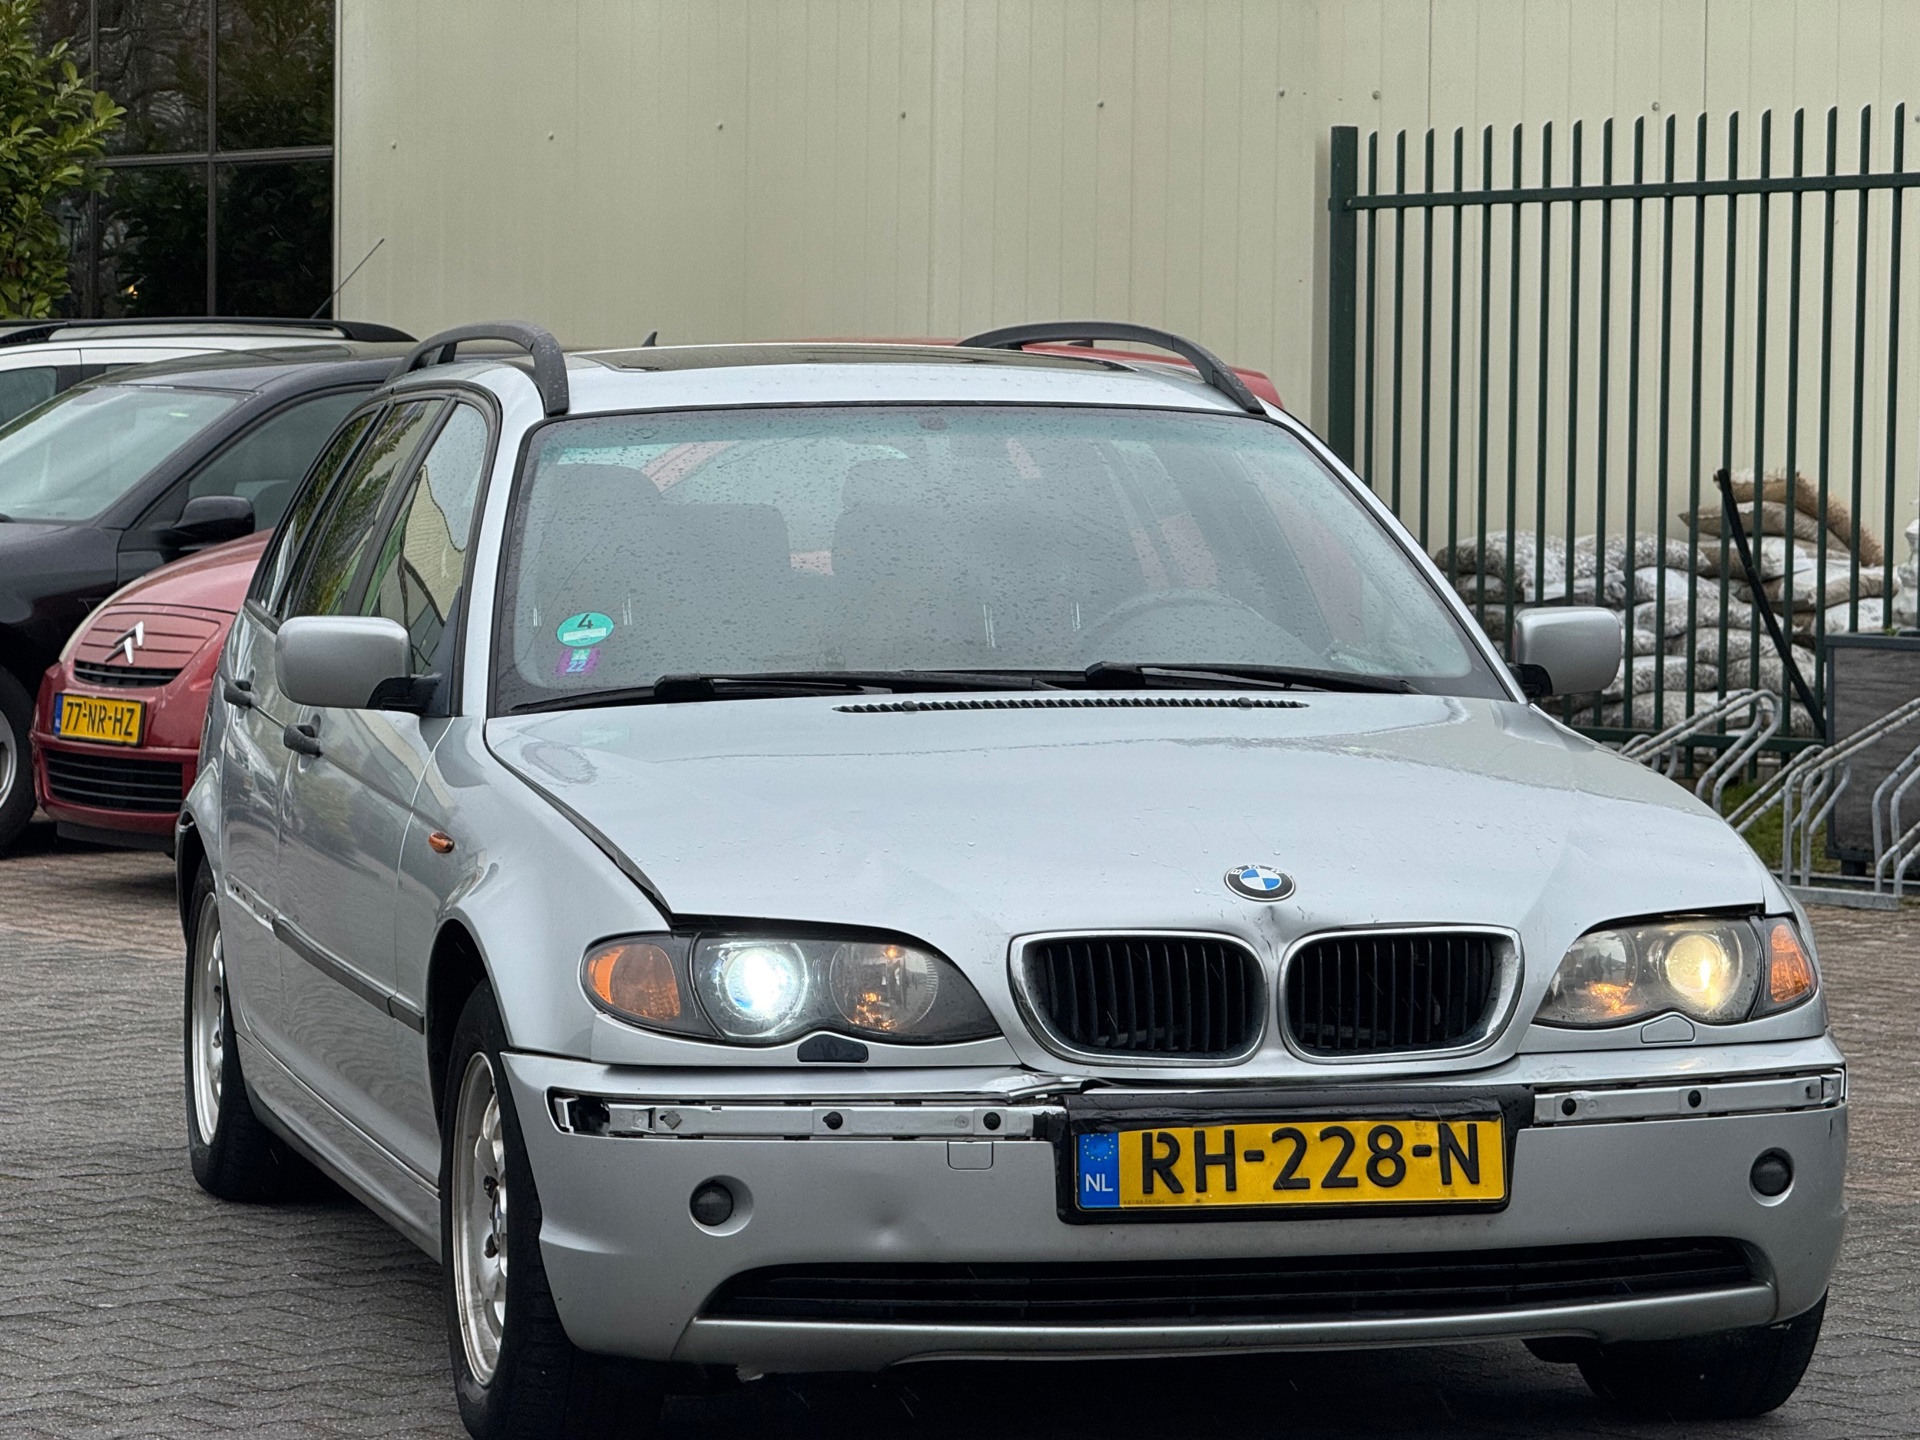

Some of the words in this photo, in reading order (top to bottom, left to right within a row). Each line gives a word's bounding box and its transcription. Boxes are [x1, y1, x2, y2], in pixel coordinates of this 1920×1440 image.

[577, 614, 593, 629] 4
[566, 660, 587, 673] 22
[65, 702, 134, 736] 77-NR-HZ
[1141, 1123, 1480, 1194] RH-228-N
[1085, 1173, 1114, 1193] NL
